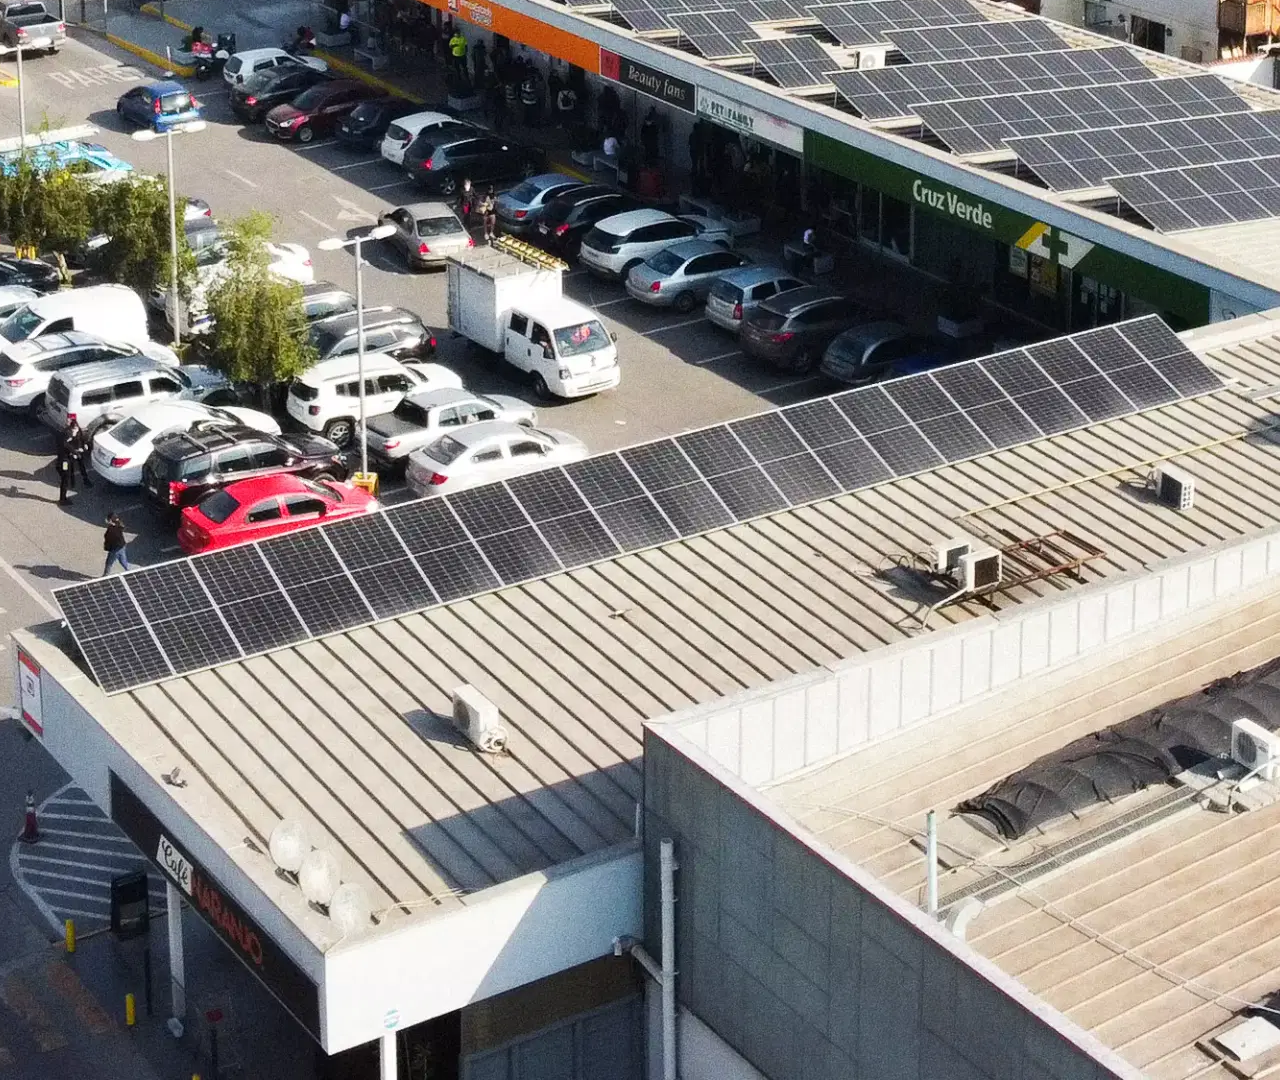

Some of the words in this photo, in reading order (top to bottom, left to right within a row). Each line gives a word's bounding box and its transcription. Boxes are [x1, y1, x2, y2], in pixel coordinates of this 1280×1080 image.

[628, 65, 662, 93] Beauty
[663, 79, 686, 101] fans
[912, 179, 946, 211] Cruz
[946, 191, 993, 229] Verde
[161, 840, 189, 887] Café
